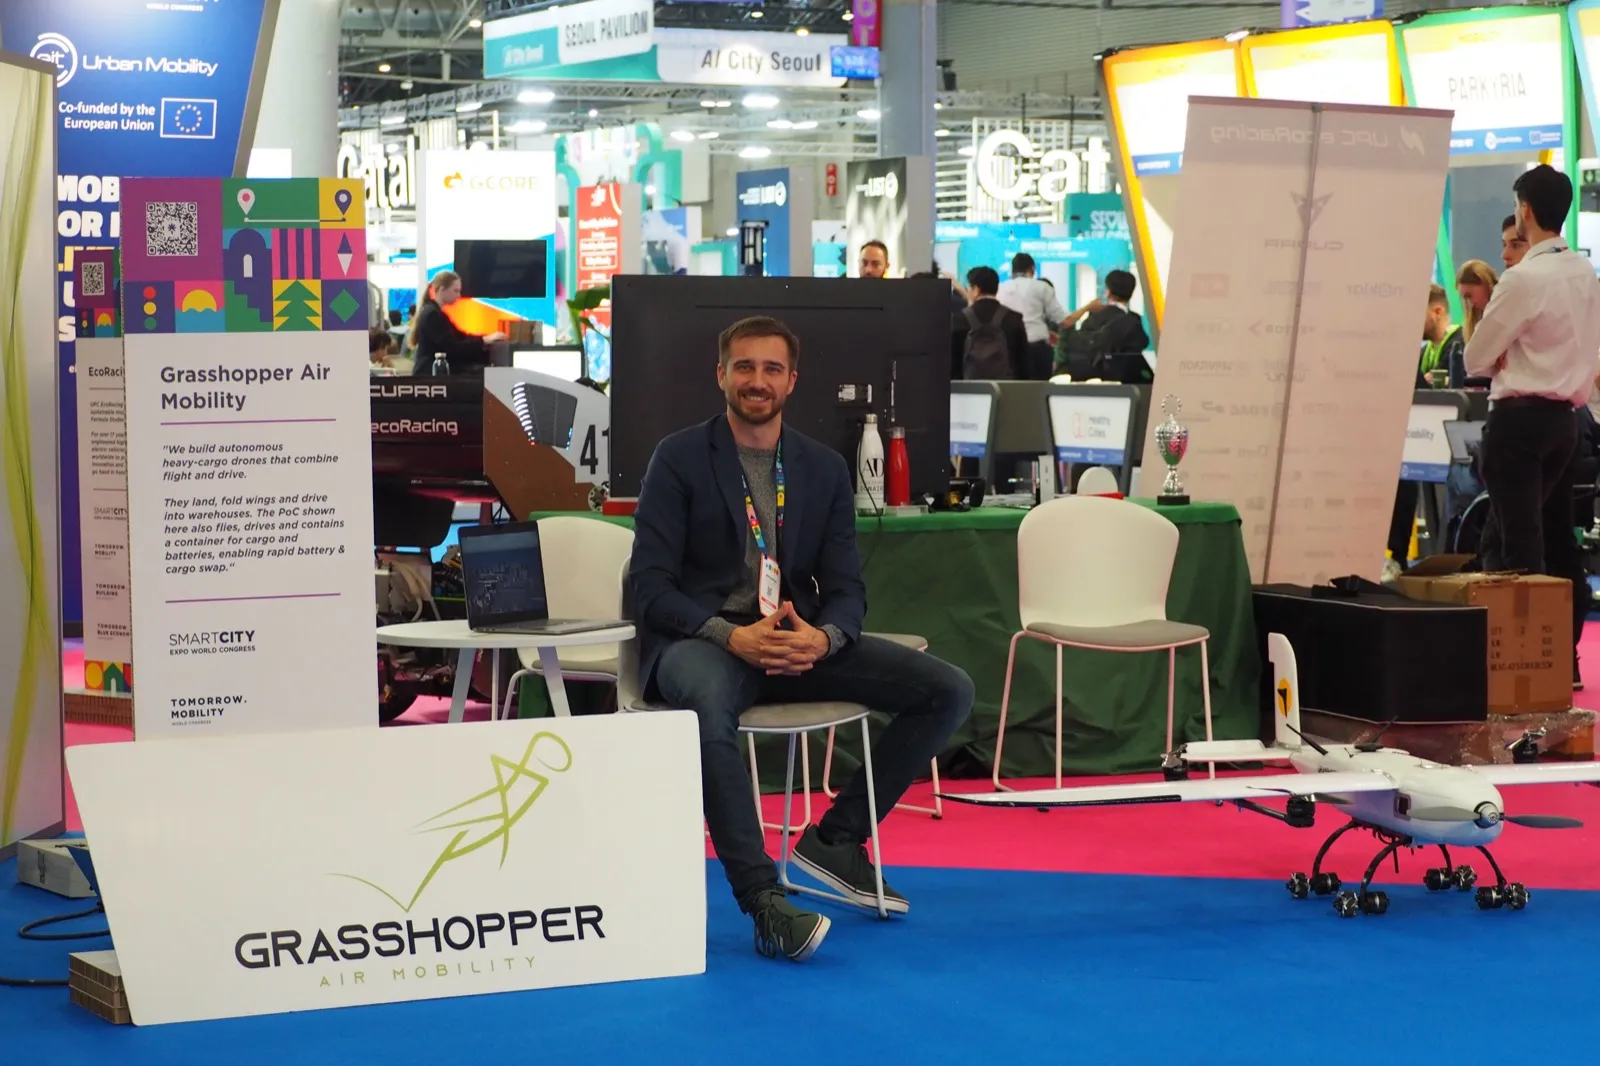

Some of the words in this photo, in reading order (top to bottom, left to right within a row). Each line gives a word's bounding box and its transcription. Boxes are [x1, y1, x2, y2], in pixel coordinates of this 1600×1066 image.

[565, 21, 597, 48] SEOUL
[601, 10, 649, 41] PAVILION
[82, 54, 142, 72] Urban
[145, 57, 219, 77] Mobility
[701, 49, 721, 68] AI
[728, 50, 764, 74] City
[771, 52, 821, 72] Seoul
[1448, 71, 1527, 101] PARKYRIA
[59, 101, 118, 115] Co-funded
[119, 102, 135, 116] by
[136, 104, 156, 116] the
[64, 117, 118, 132] European
[121, 119, 155, 131] Union
[977, 129, 1112, 201] Cat
[469, 176, 538, 190] GCORE
[57, 210, 104, 238] OR
[160, 365, 294, 385] Grasshopper
[300, 363, 331, 381] Air
[370, 385, 448, 398] CUPRA
[161, 391, 247, 412] Mobility
[370, 418, 459, 436] ecoRacing
[188, 443, 216, 454] build
[218, 443, 284, 453] autonomous
[162, 457, 228, 469] heavy-cargo
[231, 456, 268, 466] drones
[270, 455, 291, 464] that
[294, 454, 339, 464] combine
[162, 471, 192, 482] flight
[194, 470, 215, 480] and
[217, 470, 247, 480] drive.
[164, 498, 189, 509] They
[192, 497, 218, 507] land,
[221, 495, 243, 505] fold
[245, 495, 276, 506] wings
[278, 494, 299, 504] and
[301, 493, 328, 503] drive
[164, 511, 185, 521] into
[188, 510, 253, 520] warehouses.
[257, 508, 275, 518] The
[278, 507, 300, 517] PoC
[302, 506, 336, 516] shown
[164, 524, 188, 534] here
[191, 523, 213, 533] also
[216, 522, 241, 533] flies,
[244, 521, 276, 532] drives
[278, 520, 299, 530] and
[301, 519, 345, 529] contains
[164, 539, 171, 547] a
[174, 537, 224, 547] container
[227, 535, 243, 545] for
[245, 535, 276, 546] cargo
[278, 533, 299, 543] and
[165, 551, 216, 561] batteries,
[218, 549, 264, 559] enabling
[267, 547, 295, 558] rapid
[297, 545, 335, 556] battery
[338, 545, 346, 554] &
[165, 565, 196, 575] cargo
[169, 630, 256, 646] SMARTCITY
[169, 648, 189, 656] EXPO
[191, 647, 217, 655] WORLD
[219, 645, 256, 653] CONGRESS
[171, 695, 247, 707] TOMORROW.
[171, 708, 224, 719] MOBILITY
[234, 904, 606, 969] GRASSHOPPER
[319, 970, 366, 988] AIR
[392, 955, 537, 981] MOBILITY
